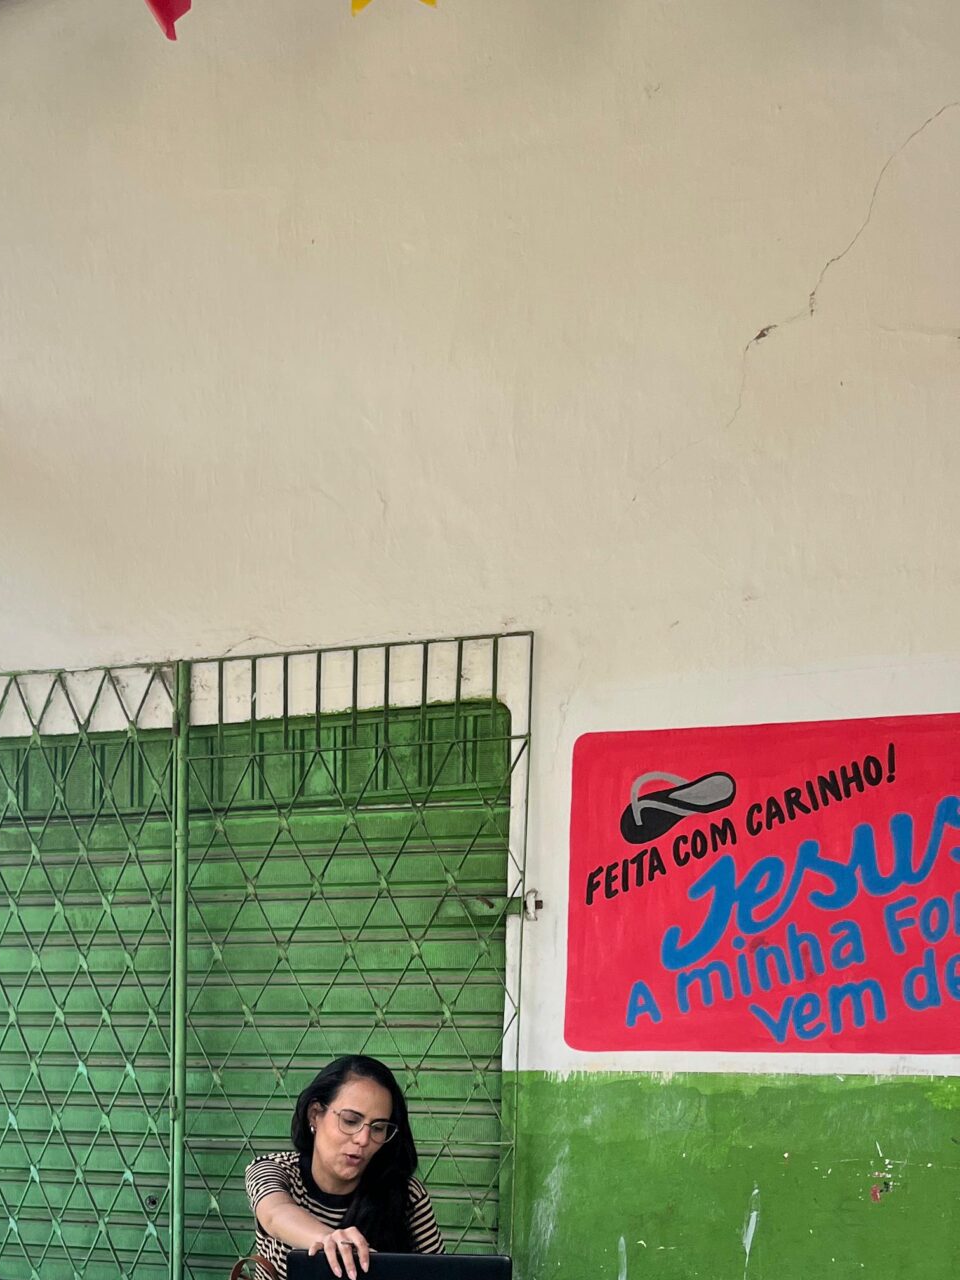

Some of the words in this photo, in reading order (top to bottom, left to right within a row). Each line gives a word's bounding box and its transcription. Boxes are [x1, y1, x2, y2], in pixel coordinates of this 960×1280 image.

[585, 846, 667, 906] FEITA
[672, 817, 737, 867] COM
[745, 742, 896, 836] CARINHO!
[625, 980, 662, 1028] A
[676, 920, 865, 1013] minha
[884, 892, 960, 954] Fo
[748, 978, 887, 1043] vem
